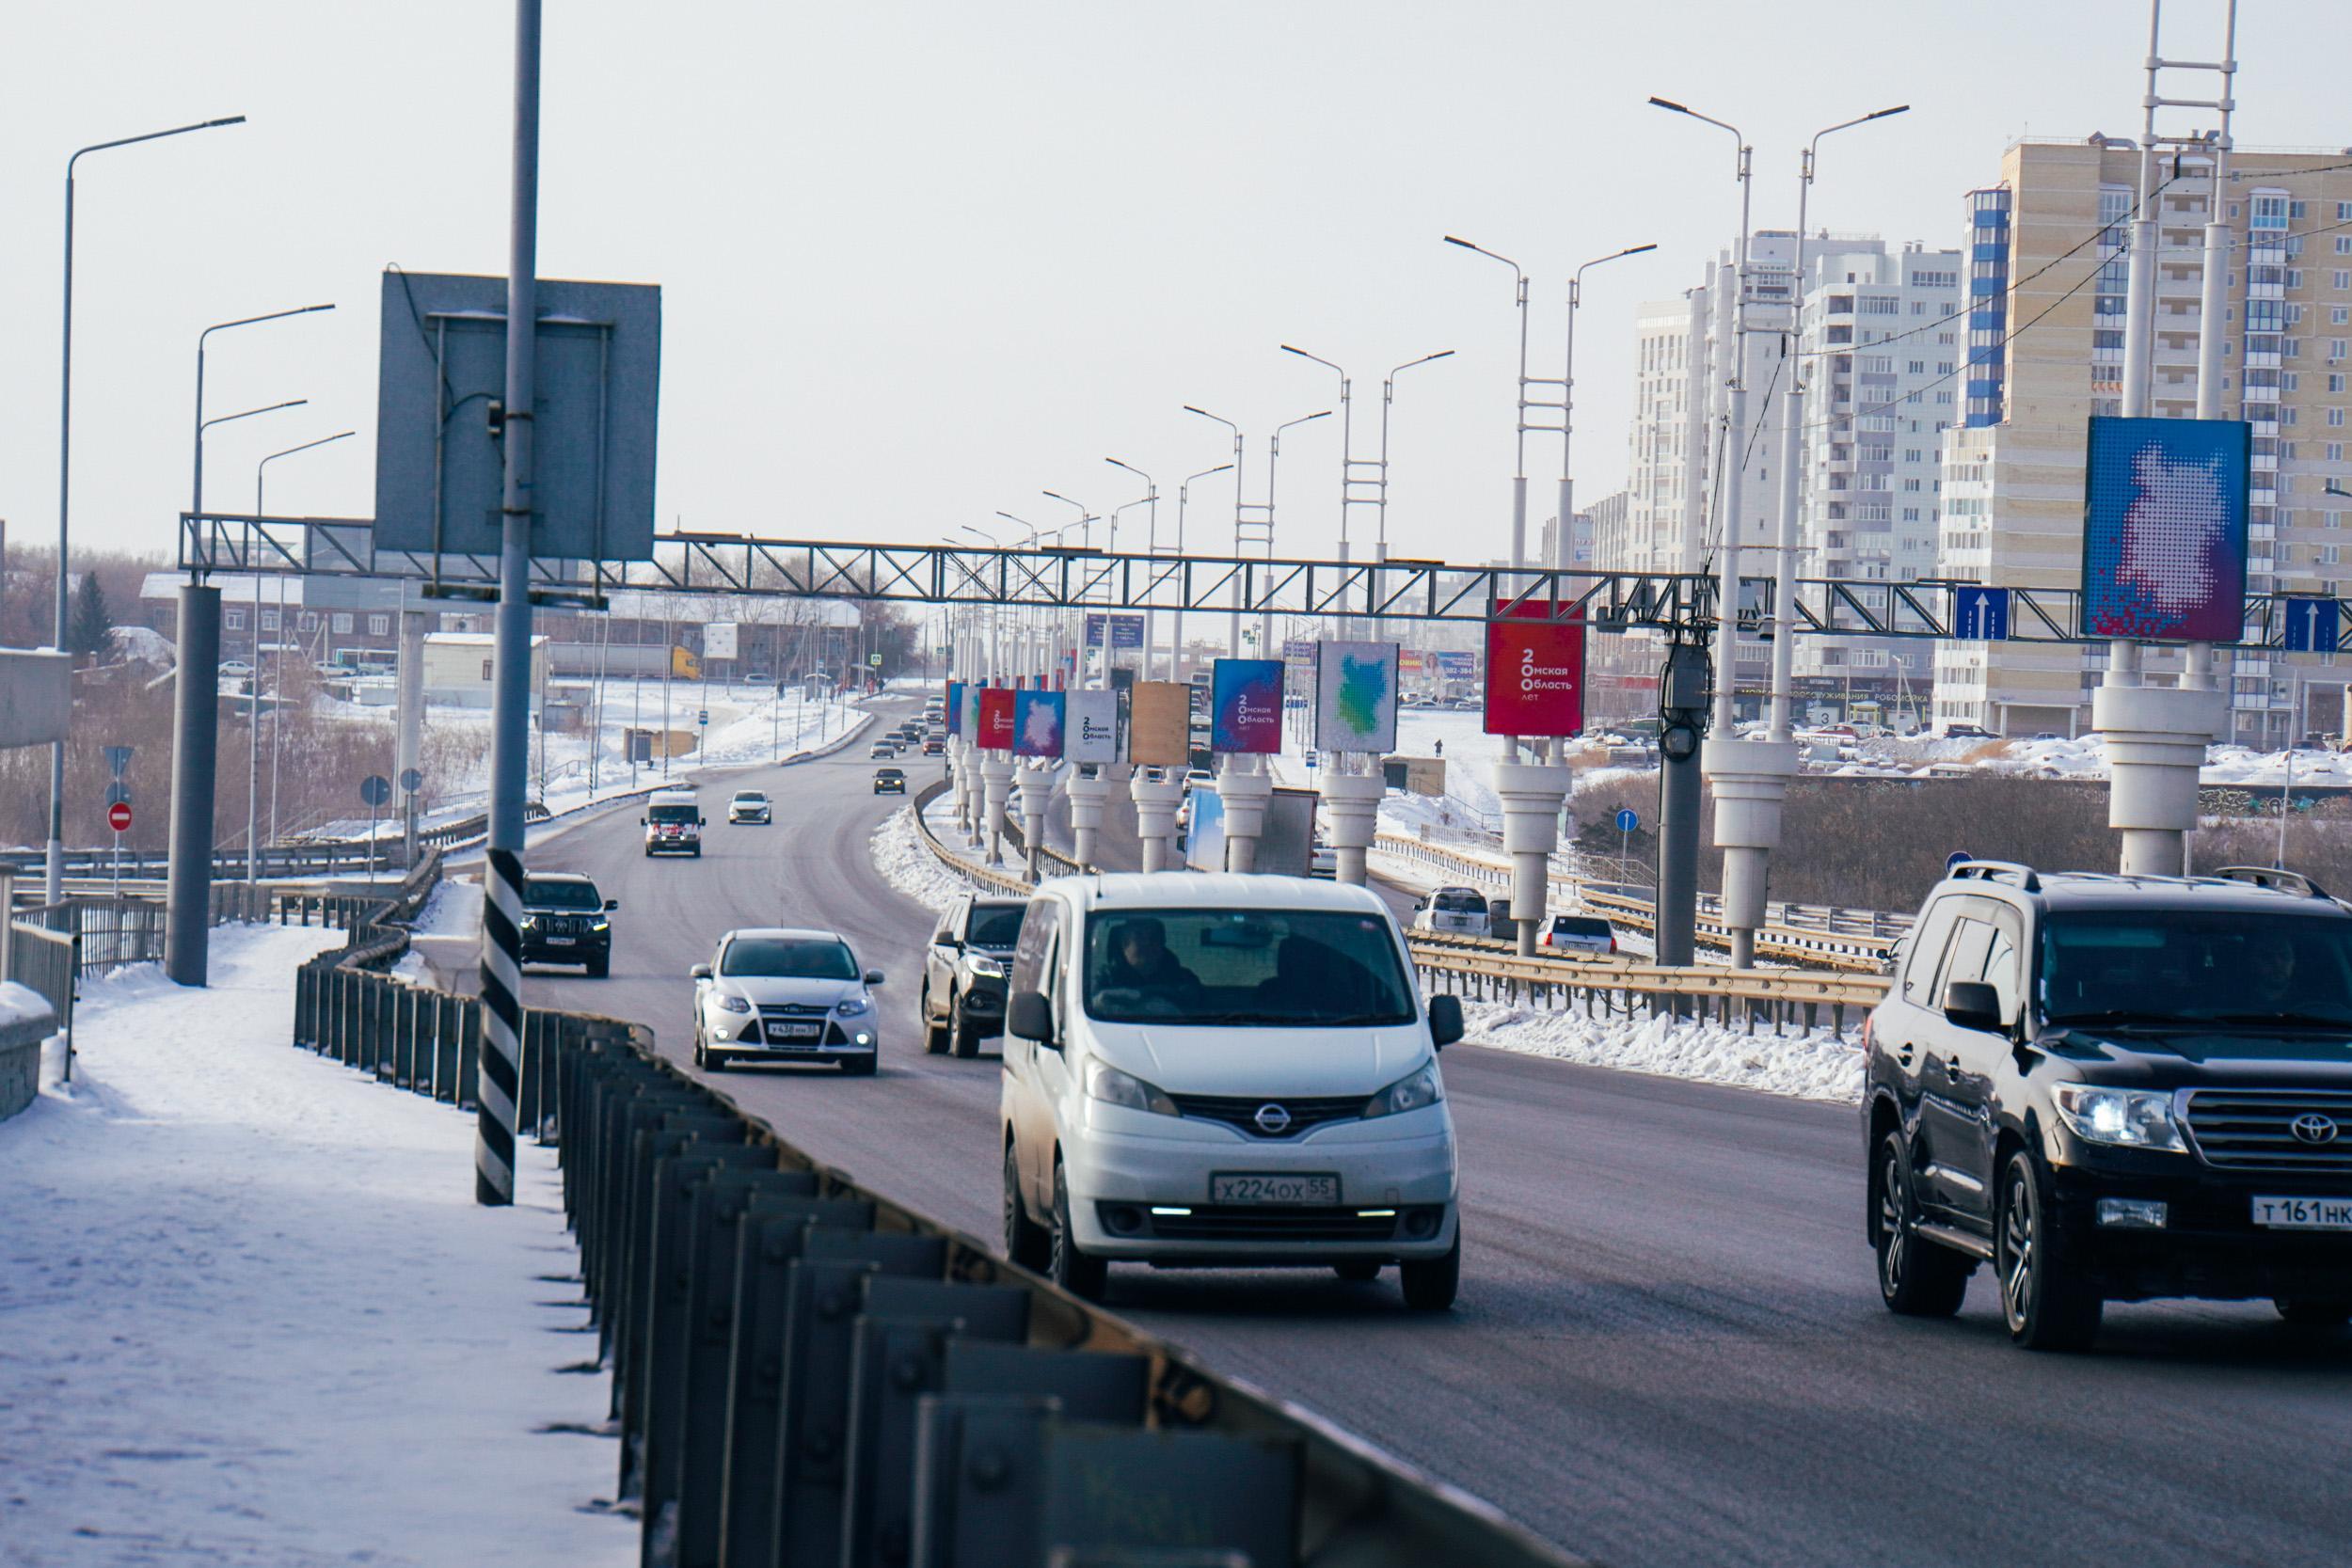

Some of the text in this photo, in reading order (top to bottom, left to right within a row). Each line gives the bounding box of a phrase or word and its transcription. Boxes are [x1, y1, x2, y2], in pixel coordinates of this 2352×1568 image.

[1521, 648, 1534, 663] 2
[1520, 664, 1568, 677] Омская
[1520, 678, 1573, 691] Область
[1239, 694, 1248, 705] 2
[1238, 705, 1272, 715] Омская
[1084, 717, 1090, 725] 2
[1237, 715, 1275, 724] Область
[1821, 712, 1830, 724] 3
[2264, 1200, 2352, 1223] Т161НК
